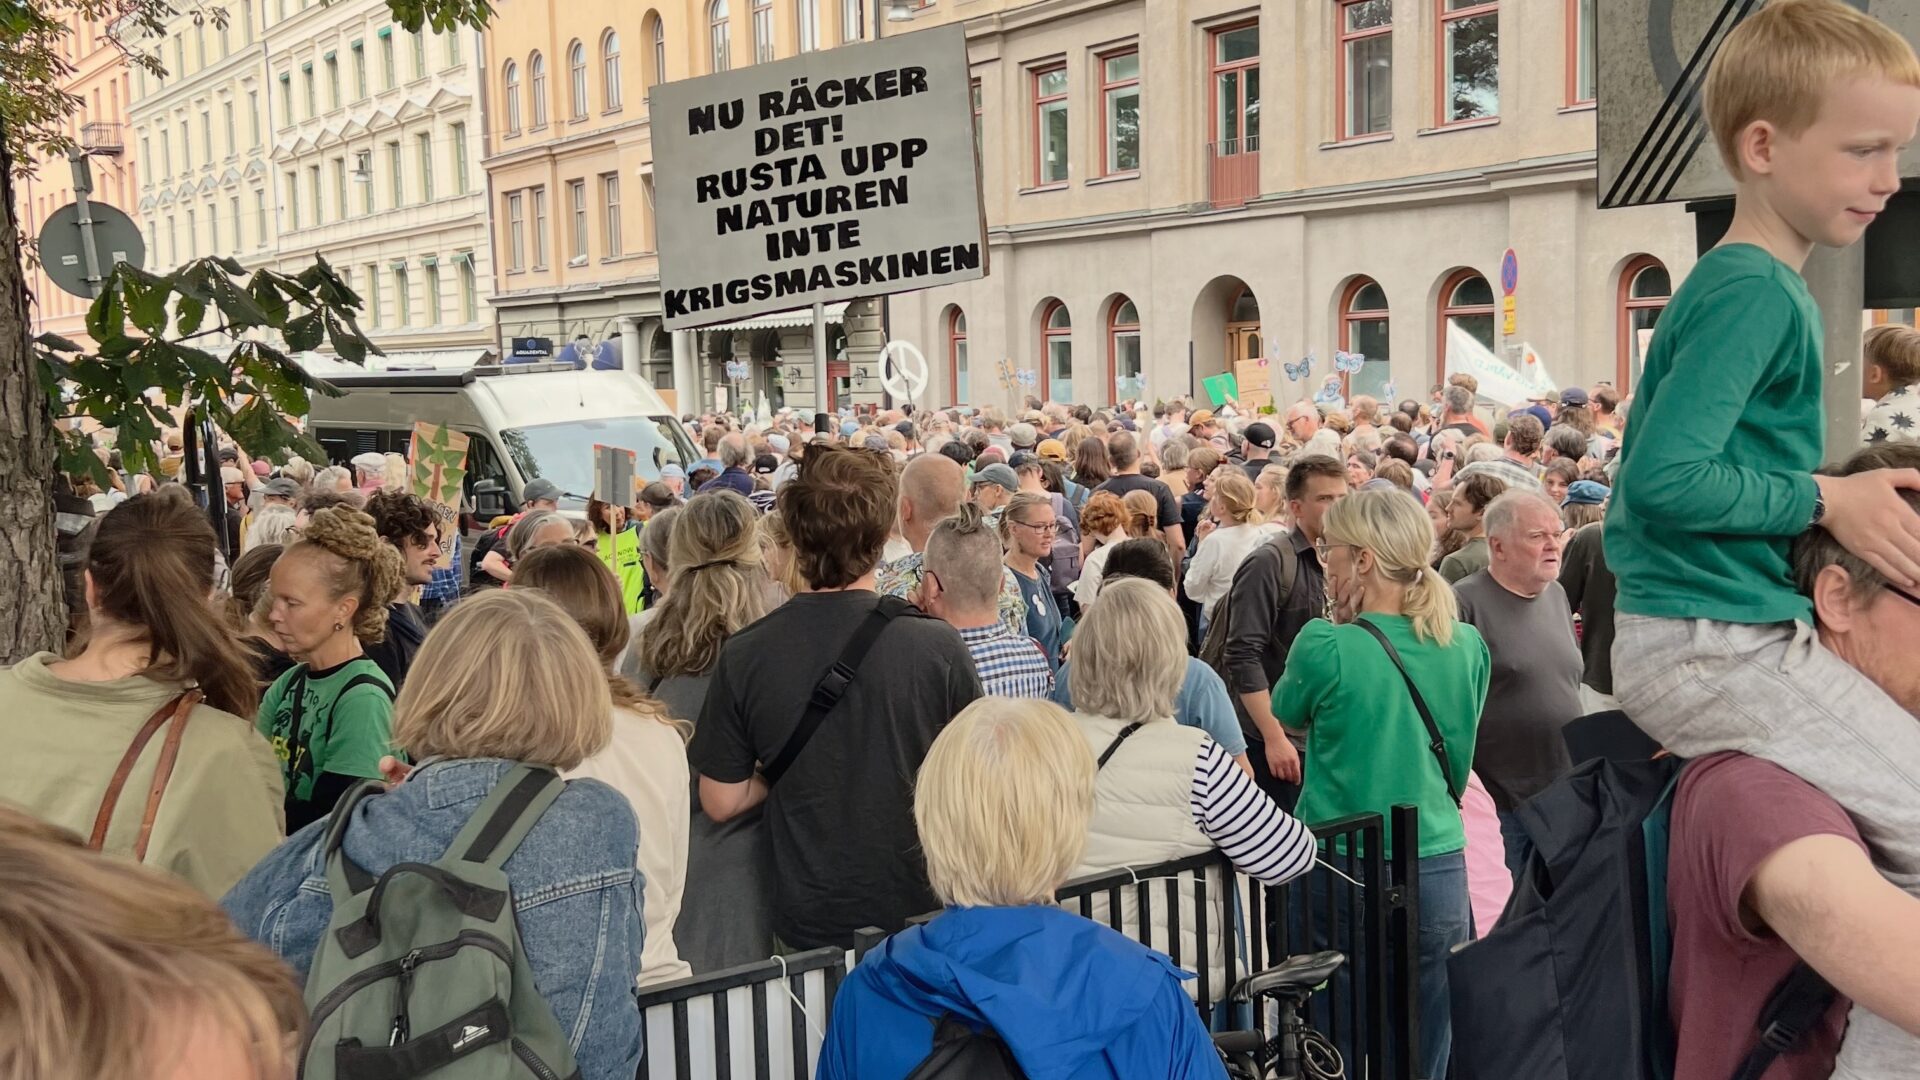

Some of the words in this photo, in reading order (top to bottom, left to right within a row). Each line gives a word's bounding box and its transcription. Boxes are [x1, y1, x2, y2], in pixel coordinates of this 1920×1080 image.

[688, 98, 744, 136] NU
[759, 66, 928, 121] RÄCKER
[755, 115, 844, 157] DET!
[696, 154, 827, 203] RUSTA
[841, 138, 928, 176] UPP
[716, 175, 909, 236] NATUREN
[766, 220, 861, 262] INTE
[664, 243, 980, 319] KRIGSMASKINEN
